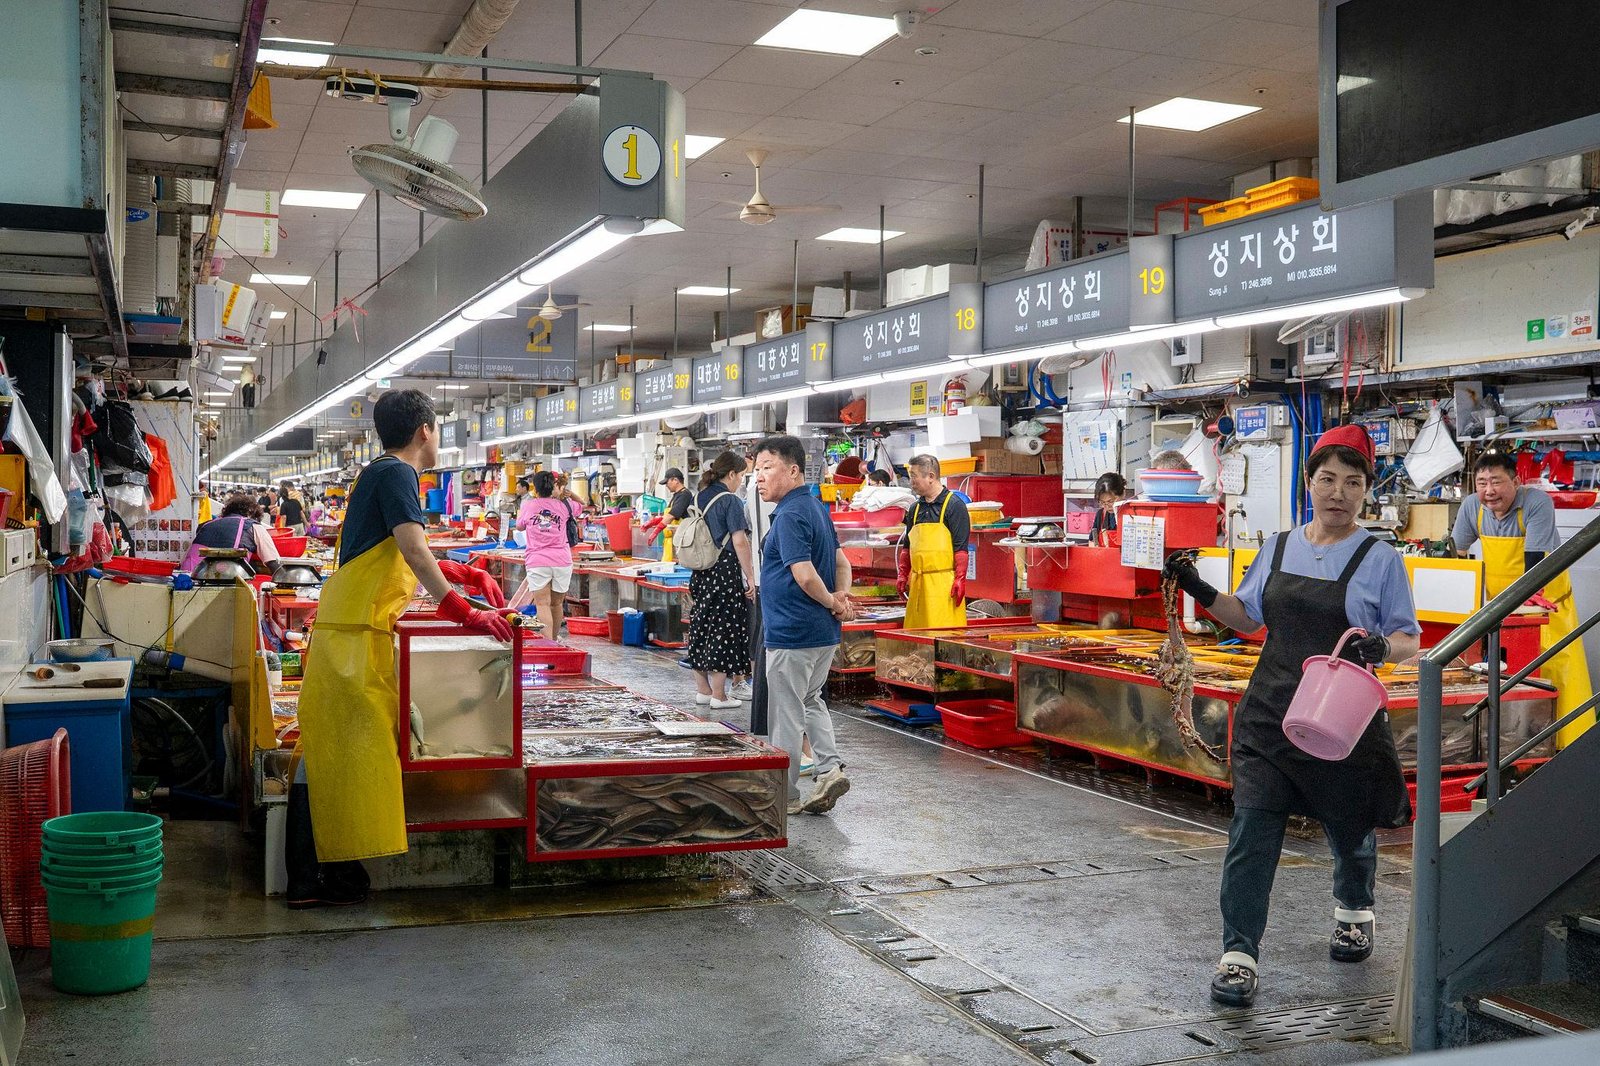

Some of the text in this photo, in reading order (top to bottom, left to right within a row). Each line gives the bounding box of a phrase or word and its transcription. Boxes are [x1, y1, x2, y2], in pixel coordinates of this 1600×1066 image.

[621, 133, 642, 180] 1
[672, 138, 679, 179] 1
[1208, 214, 1337, 278] 성지상회
[1139, 266, 1165, 295] 19
[1015, 270, 1101, 318] 성지상회
[863, 312, 920, 350] 성지상회
[955, 307, 976, 331] 18
[525, 315, 553, 353] 2
[810, 342, 827, 361] 17
[674, 374, 690, 390] 367
[725, 363, 739, 380] 16
[565, 399, 577, 411] 14
[620, 387, 632, 401] 15
[496, 416, 505, 428] 12
[525, 409, 534, 421] 13
